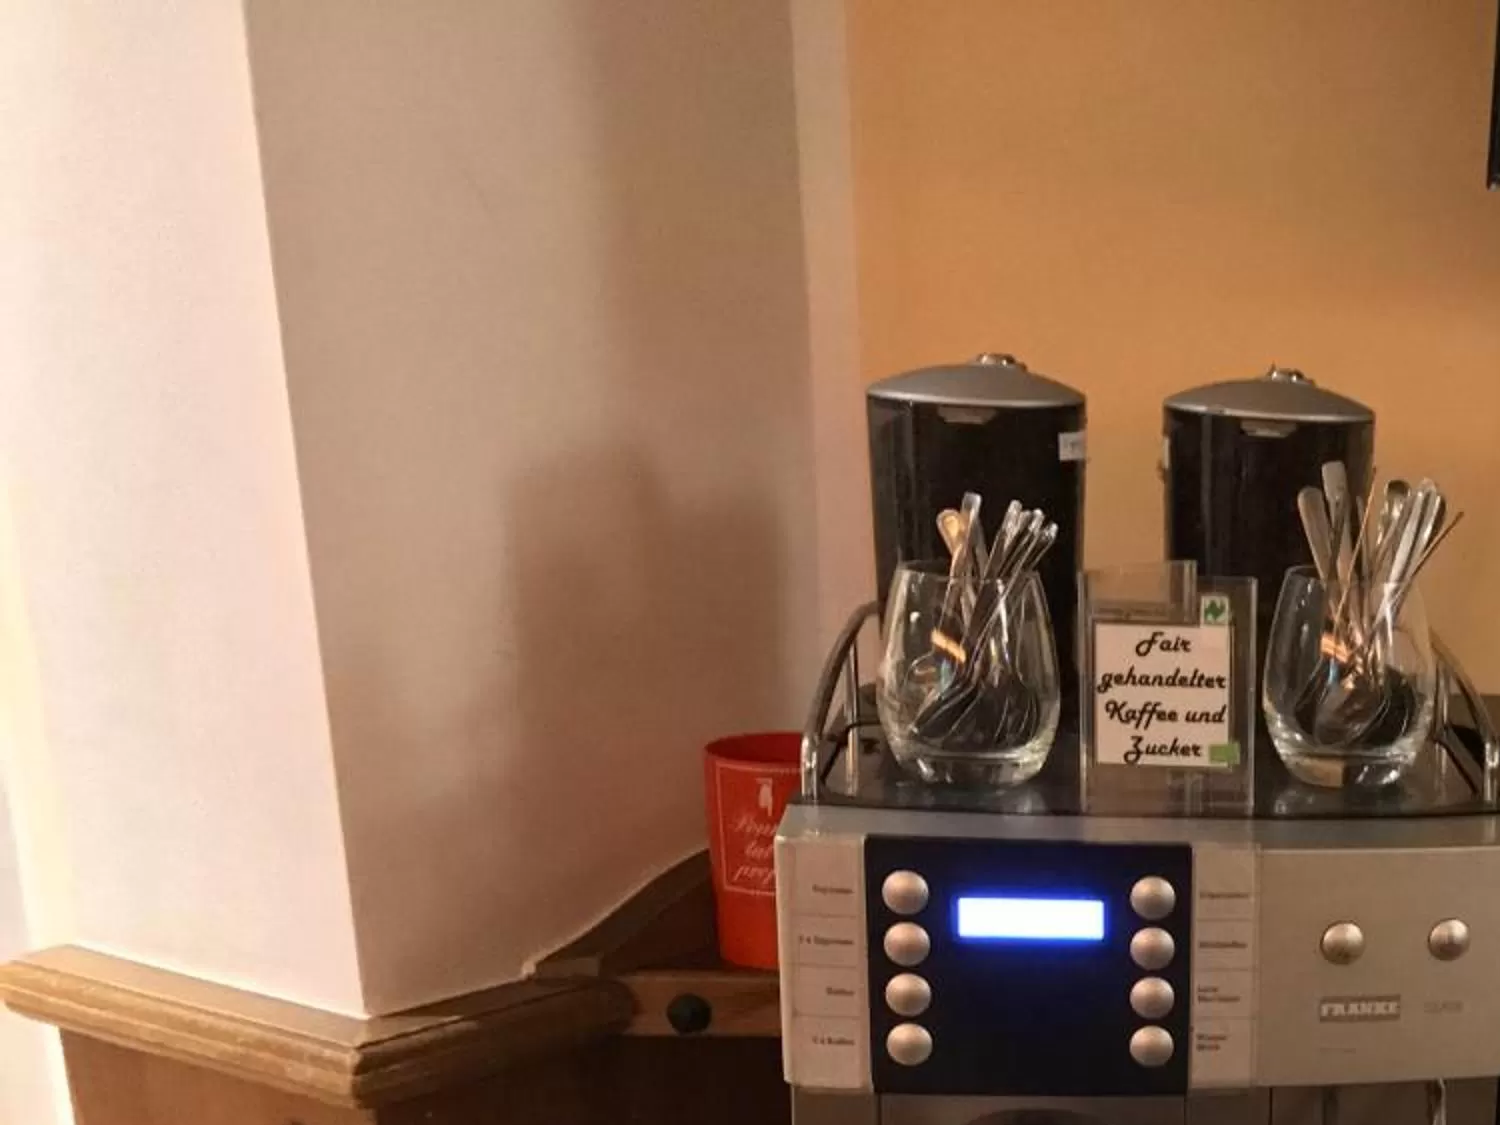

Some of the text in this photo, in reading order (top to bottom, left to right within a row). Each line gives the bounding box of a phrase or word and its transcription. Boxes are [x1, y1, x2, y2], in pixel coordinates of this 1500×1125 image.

[1135, 631, 1192, 657] Fair
[1097, 664, 1227, 694] gehandelter
[1105, 699, 1227, 731] Kaffee und
[1123, 735, 1203, 764] Zucker
[1320, 1000, 1399, 1018] FRANKE
